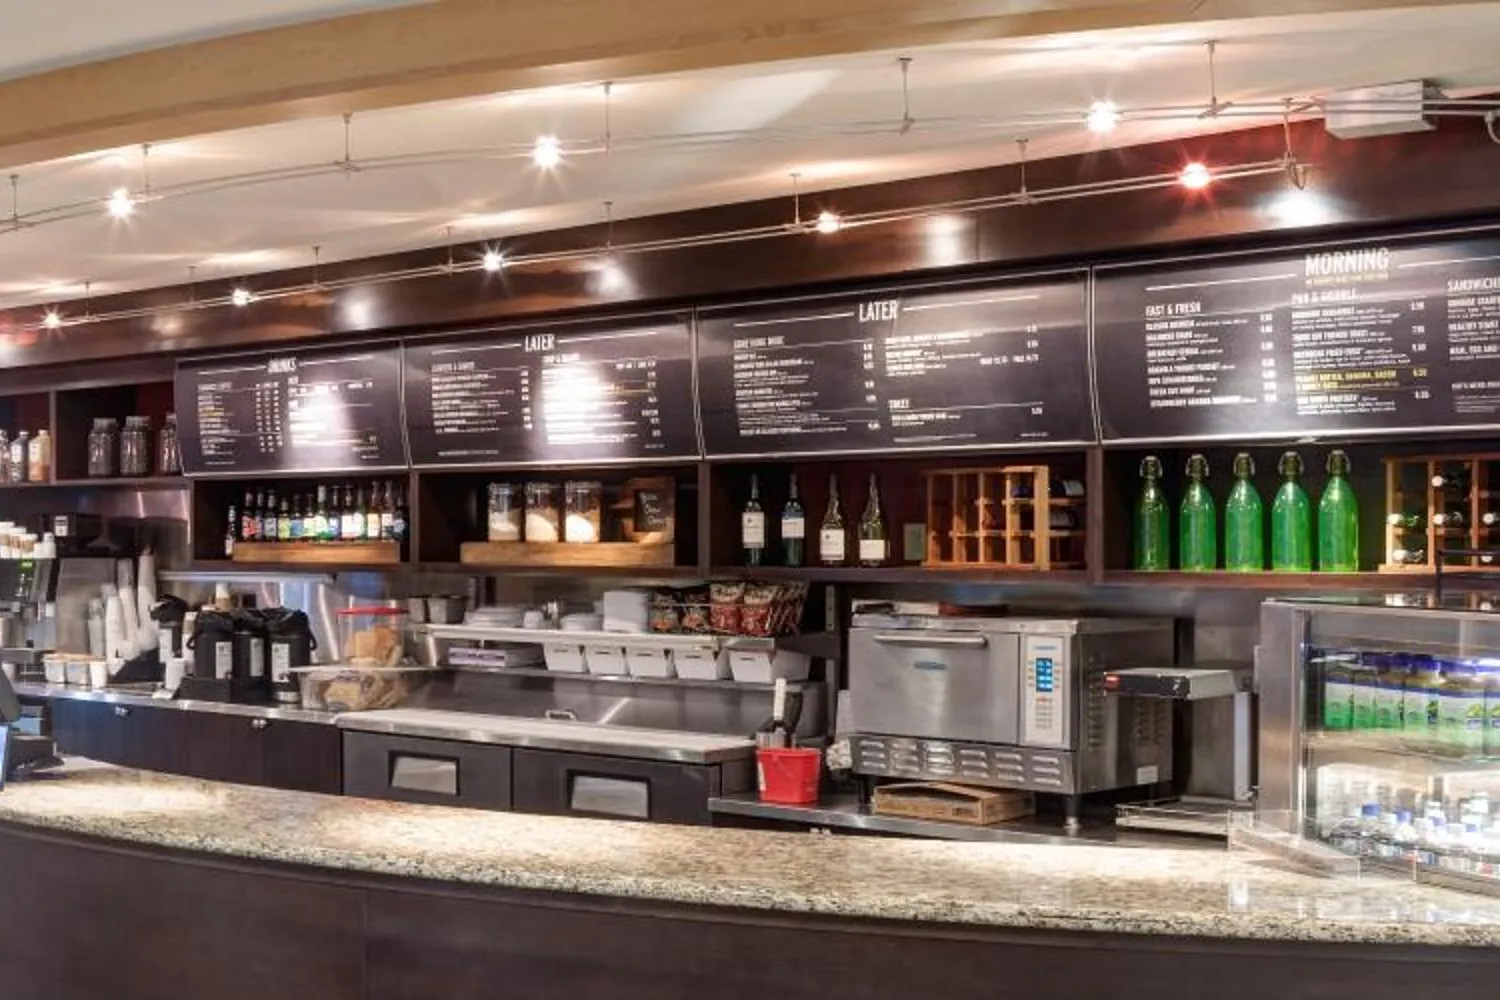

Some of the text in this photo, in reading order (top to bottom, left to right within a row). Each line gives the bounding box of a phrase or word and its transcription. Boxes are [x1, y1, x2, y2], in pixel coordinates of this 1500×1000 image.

[1305, 247, 1389, 276] MORNING
[859, 300, 898, 322] LATER
[525, 334, 555, 353] LATER
